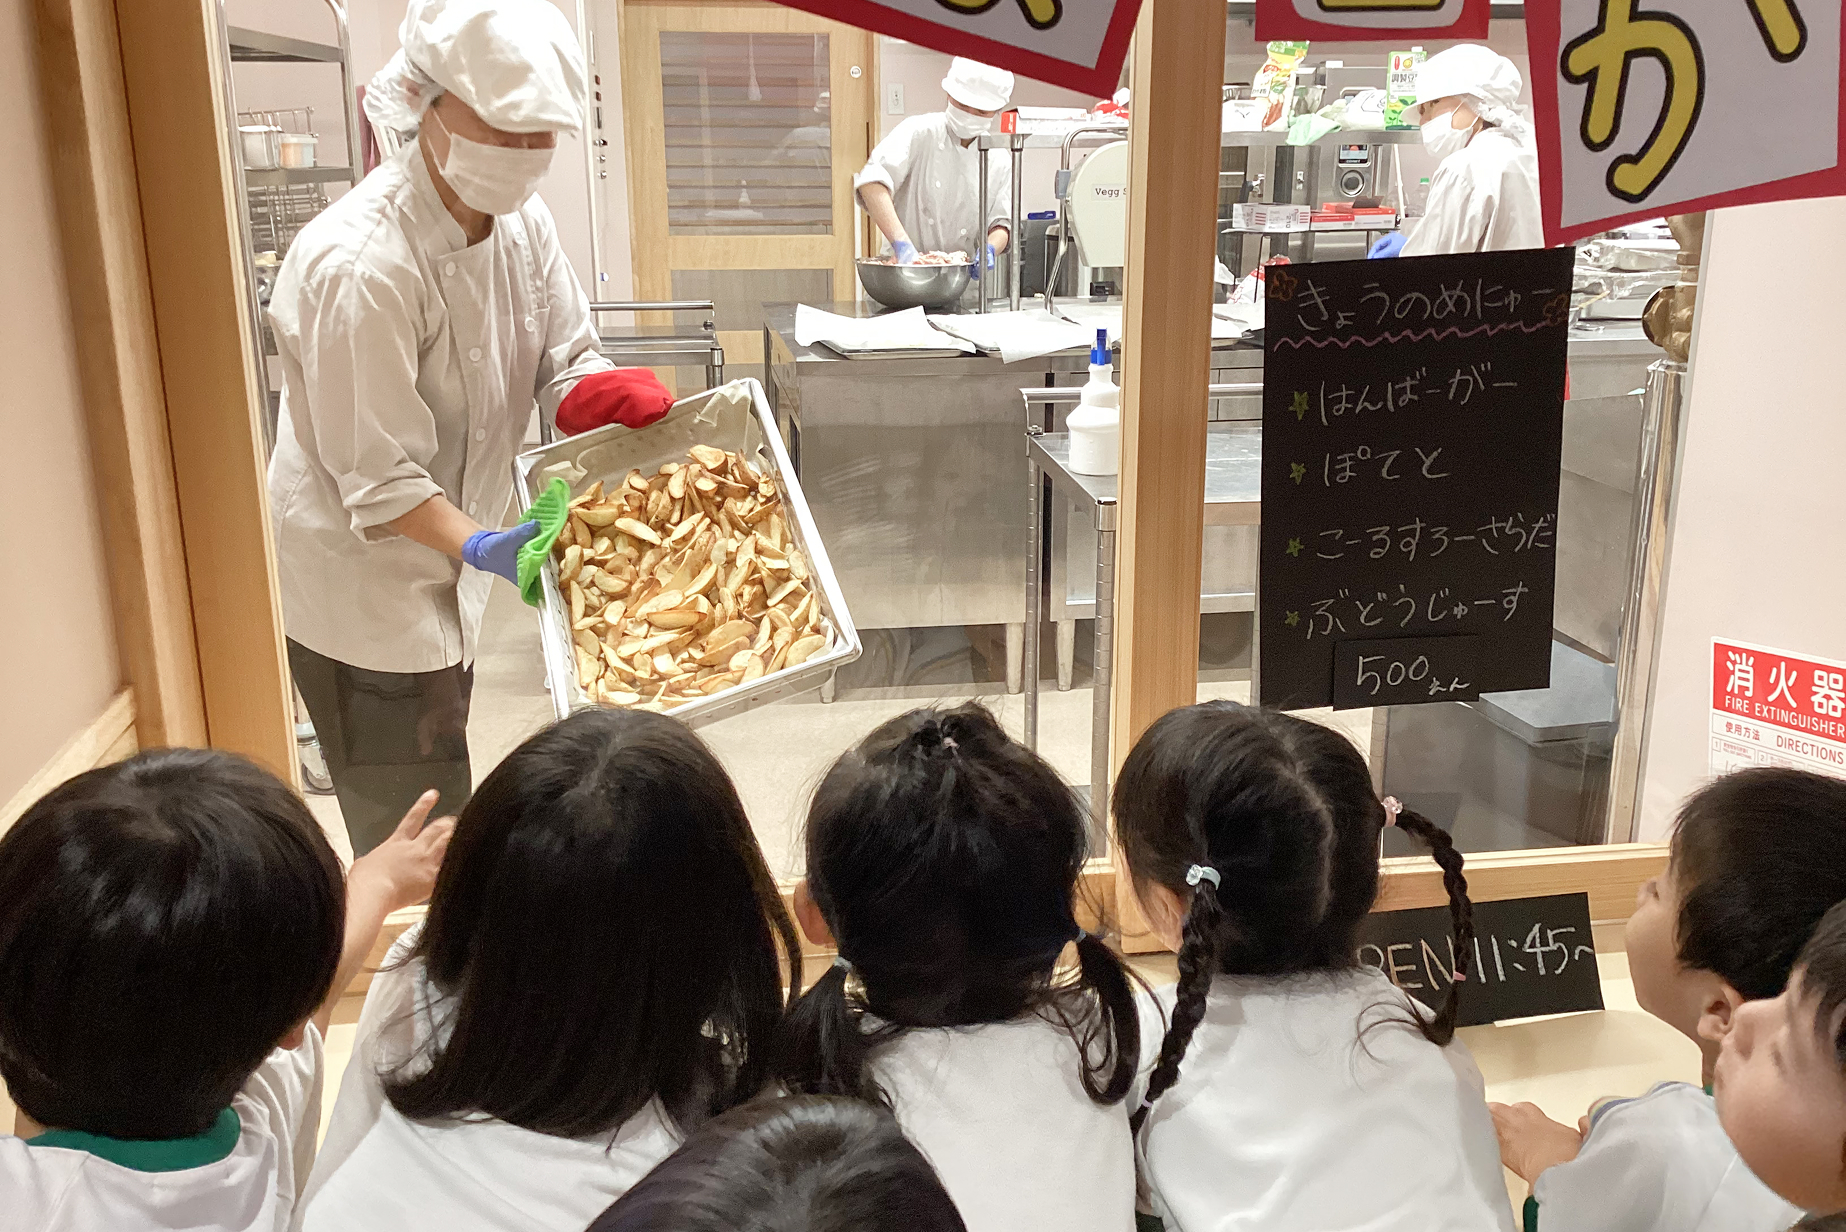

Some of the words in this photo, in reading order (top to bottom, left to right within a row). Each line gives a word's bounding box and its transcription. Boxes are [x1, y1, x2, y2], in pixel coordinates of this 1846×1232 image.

[1391, 73, 1418, 83] 調製豆
[1094, 187, 1120, 198] Vegg
[1296, 277, 1556, 332] きょうのめにゅー
[1319, 360, 1518, 427] はんばーがー
[1323, 444, 1450, 487] ぽてと
[1316, 512, 1555, 562] こーるすろーさらだ
[1305, 580, 1529, 640] ぶどうじゅーす
[1726, 650, 1846, 718] 消火器
[1725, 695, 1750, 714] FIRE
[1754, 702, 1846, 739] EXTINGUISHER
[1725, 721, 1761, 742] 使用方法
[1776, 734, 1845, 765] DIRECTIONS
[1356, 934, 1456, 991] PEN
